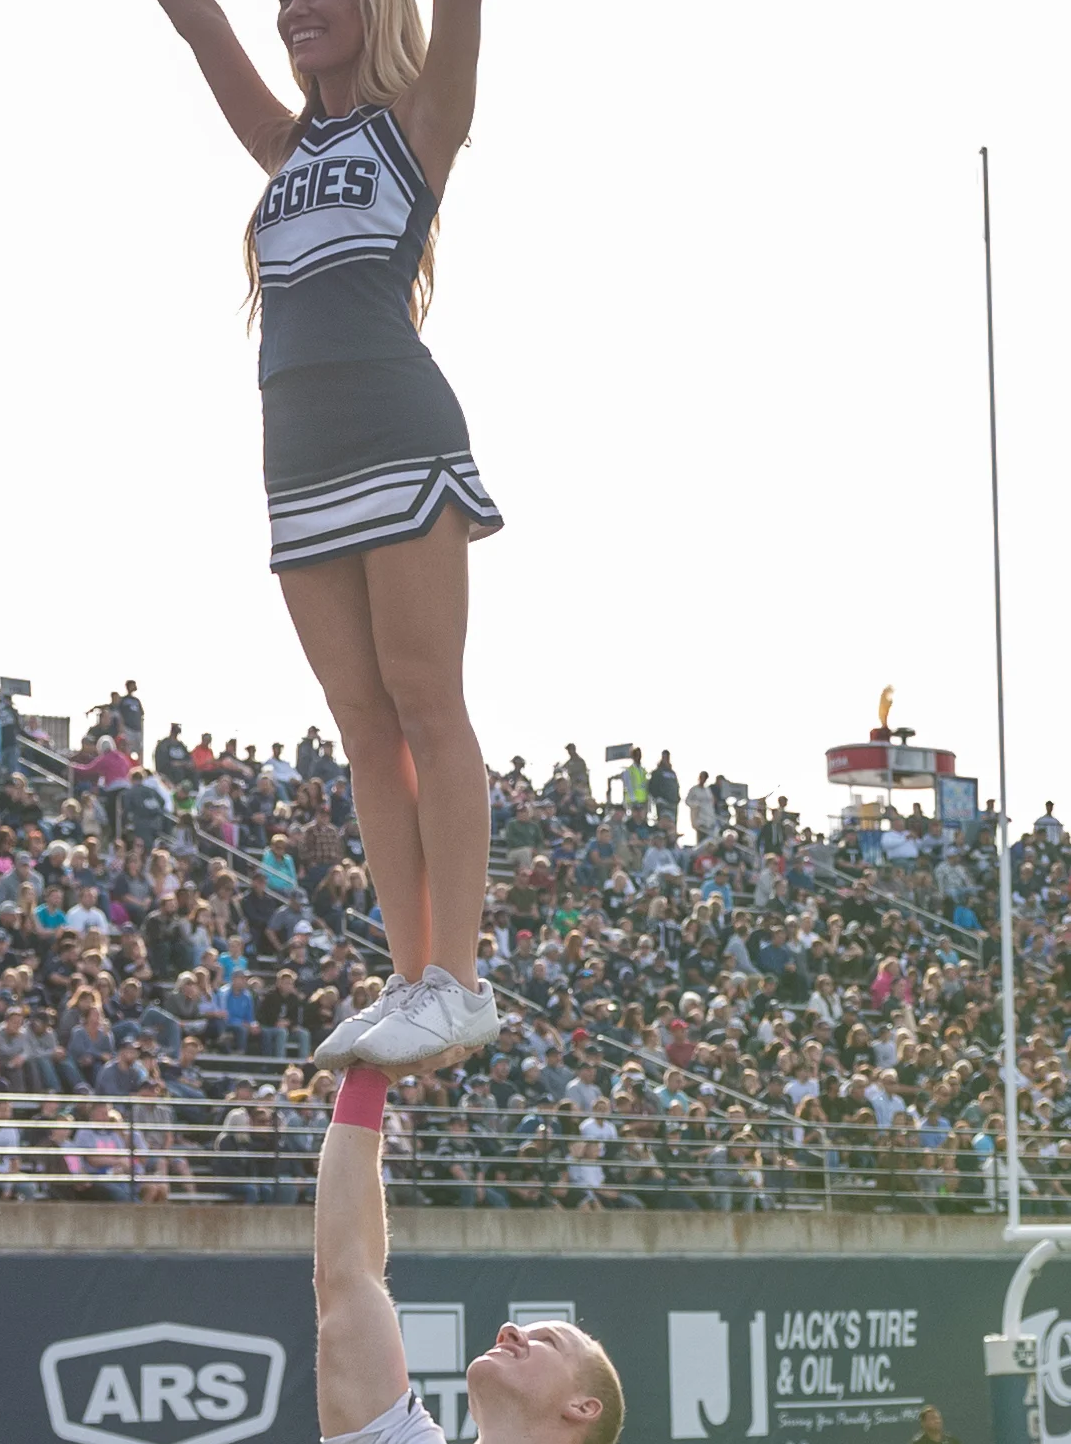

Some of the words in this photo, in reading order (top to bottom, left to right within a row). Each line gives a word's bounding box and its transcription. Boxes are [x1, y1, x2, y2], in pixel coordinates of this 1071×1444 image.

[775, 1309, 861, 1350] JACK'S
[866, 1309, 918, 1348] TIRE
[83, 1362, 249, 1424] ARS
[777, 1356, 794, 1395] &
[800, 1355, 844, 1400] OIL,
[849, 1354, 896, 1393] INC.
